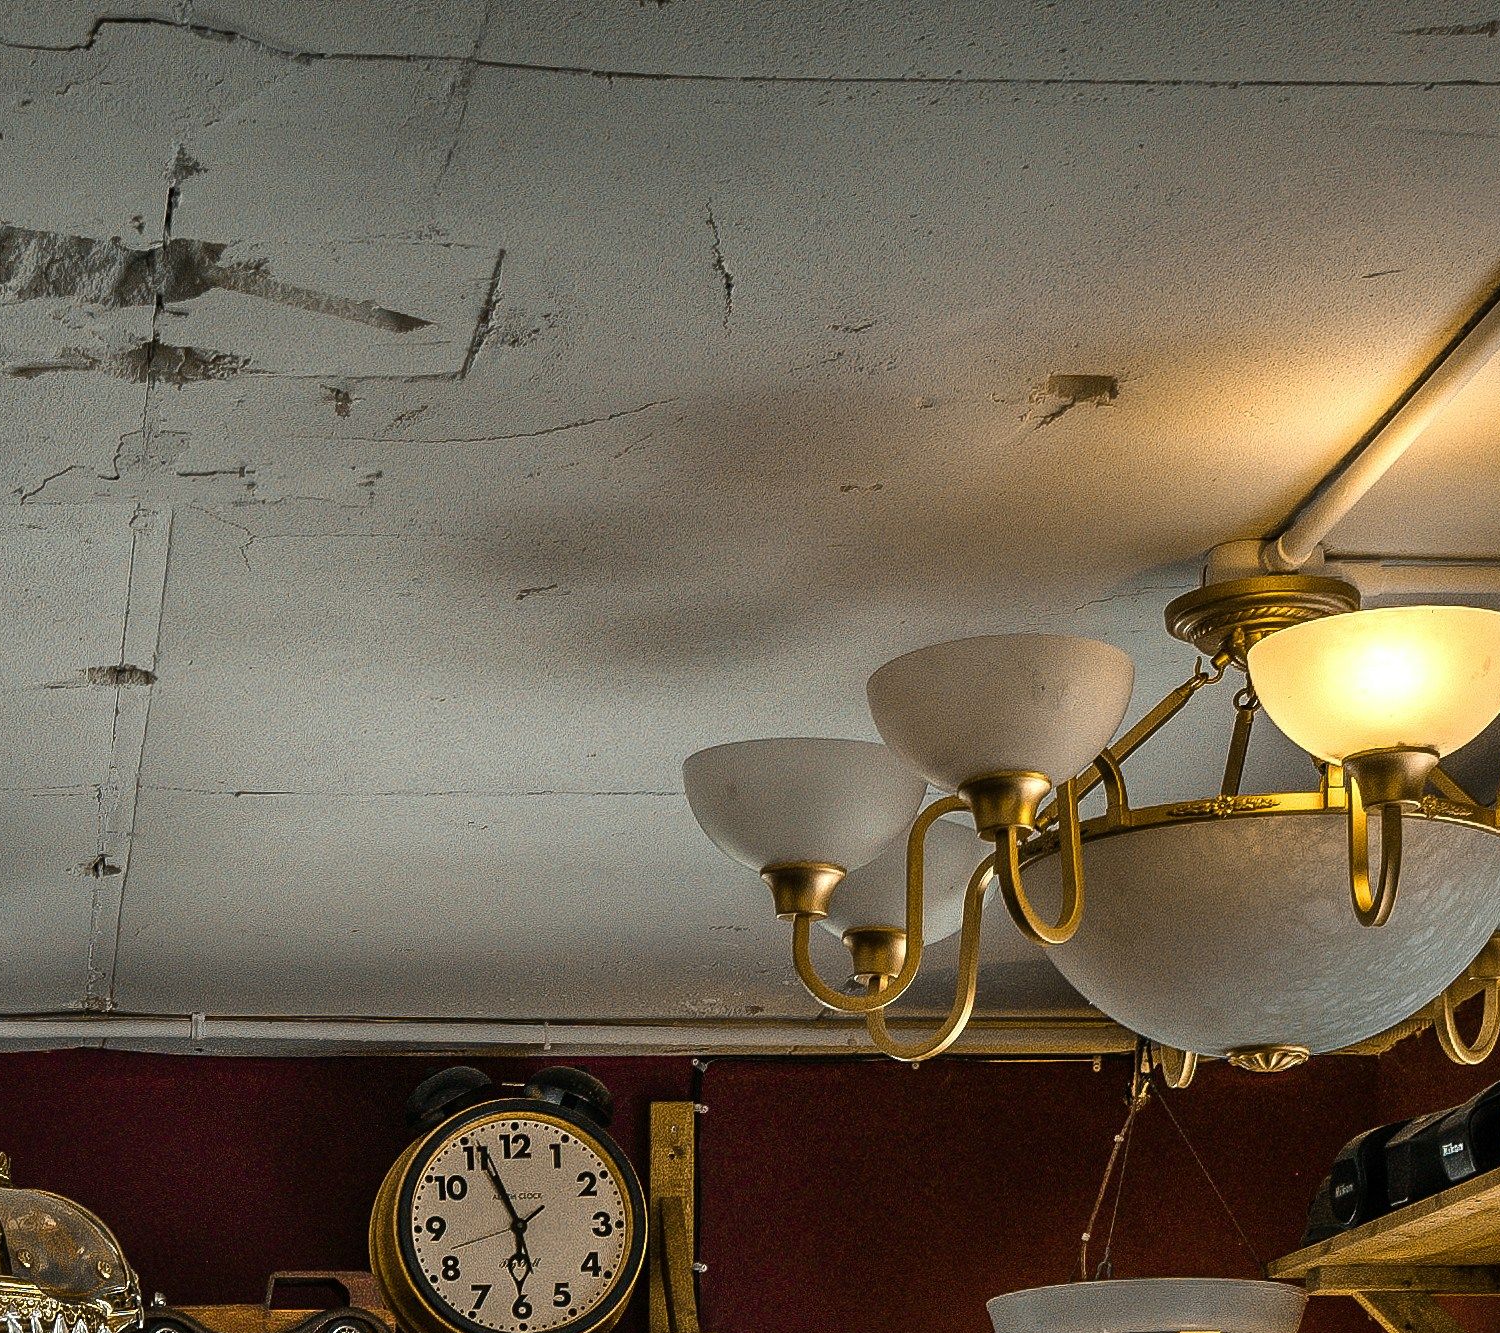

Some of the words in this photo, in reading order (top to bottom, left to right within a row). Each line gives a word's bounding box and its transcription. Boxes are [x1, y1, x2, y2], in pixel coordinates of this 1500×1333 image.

[463, 1146, 488, 1171] 11
[499, 1134, 531, 1159] 12
[549, 1143, 561, 1169] 1
[1442, 1142, 1464, 1157] Nikon
[434, 1175, 468, 1201] 10
[518, 1192, 544, 1200] CLOCK
[577, 1171, 598, 1197] 2
[425, 1215, 447, 1242] 9
[592, 1211, 613, 1238] 3
[441, 1255, 461, 1282] 8
[580, 1251, 602, 1278] 4
[470, 1284, 492, 1310] 7
[512, 1294, 533, 1320] 6
[552, 1282, 572, 1308] 5
